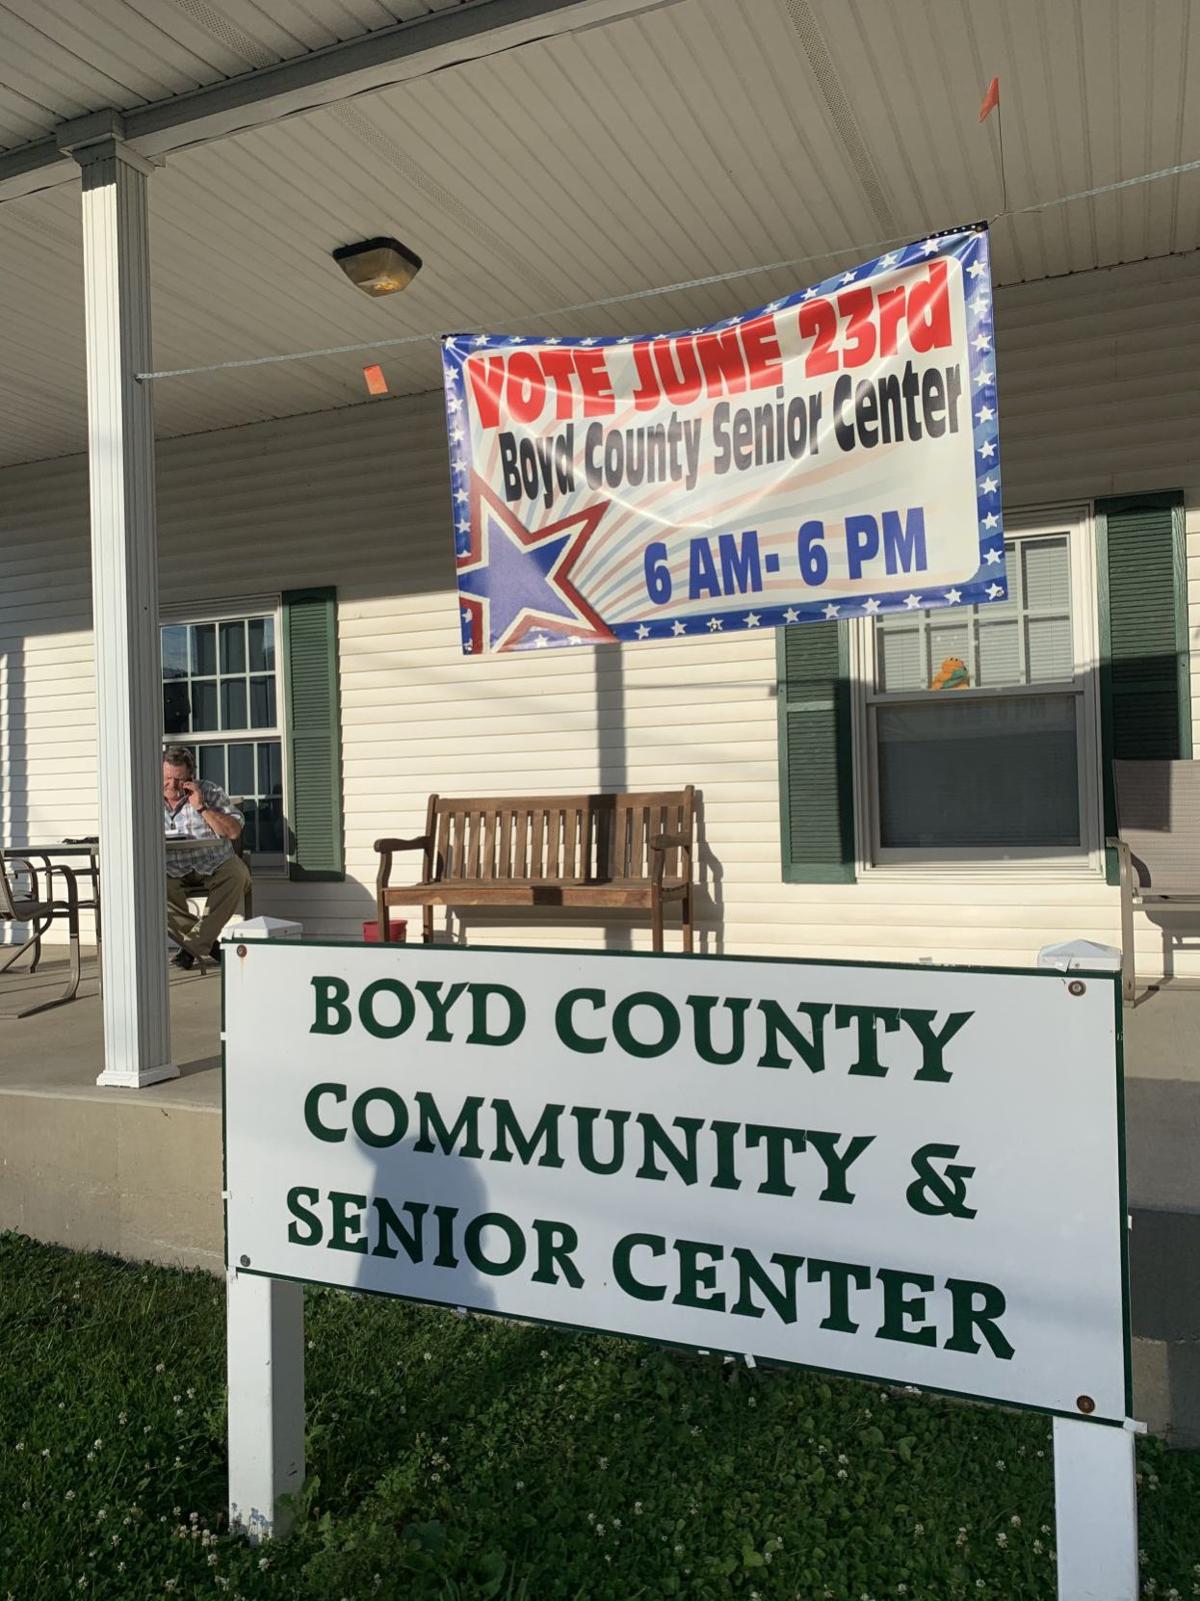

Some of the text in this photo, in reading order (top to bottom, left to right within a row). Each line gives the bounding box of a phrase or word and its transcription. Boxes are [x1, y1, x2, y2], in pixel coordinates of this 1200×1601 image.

[467, 260, 953, 429] VOTE JUNE 23rd
[499, 360, 961, 508] Boyd County Senior Center
[644, 542, 672, 605] 6
[799, 521, 829, 586] 6
[845, 507, 928, 579] PM
[309, 976, 975, 1083] BOYD COUNTY
[304, 1082, 978, 1220] COMMUNITY &
[286, 1186, 1016, 1361] SENIOR CENTER
